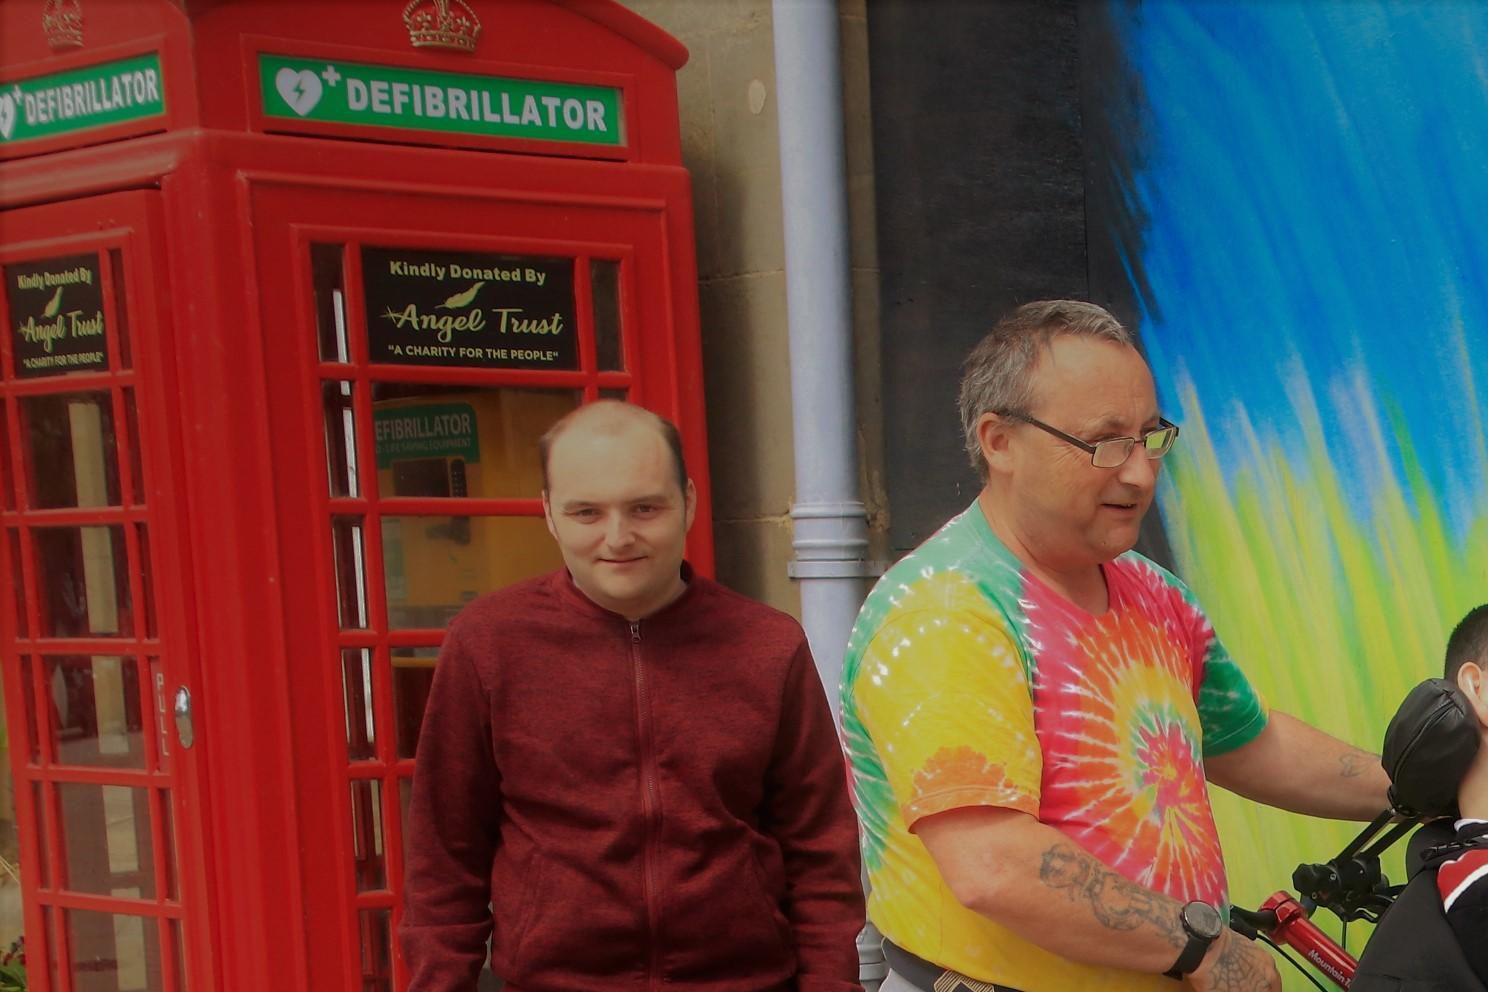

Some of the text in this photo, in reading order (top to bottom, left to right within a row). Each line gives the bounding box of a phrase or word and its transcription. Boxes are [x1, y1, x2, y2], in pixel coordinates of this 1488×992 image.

[24, 69, 160, 126] DEFIBRILLATOR
[346, 78, 608, 132] DEFIBRILLATOR
[17, 267, 93, 291] Kindly Donated By
[389, 261, 546, 286] Kindly Donated By
[18, 310, 104, 353] Angel Trust
[380, 304, 564, 343] Angel Trust
[405, 345, 457, 357] CHARITY
[459, 347, 483, 359] FOR
[485, 348, 508, 360] THE
[375, 413, 471, 441] EFIBRILLATOR
[156, 672, 170, 757] PULL
[1307, 949, 1347, 984] Mountain
